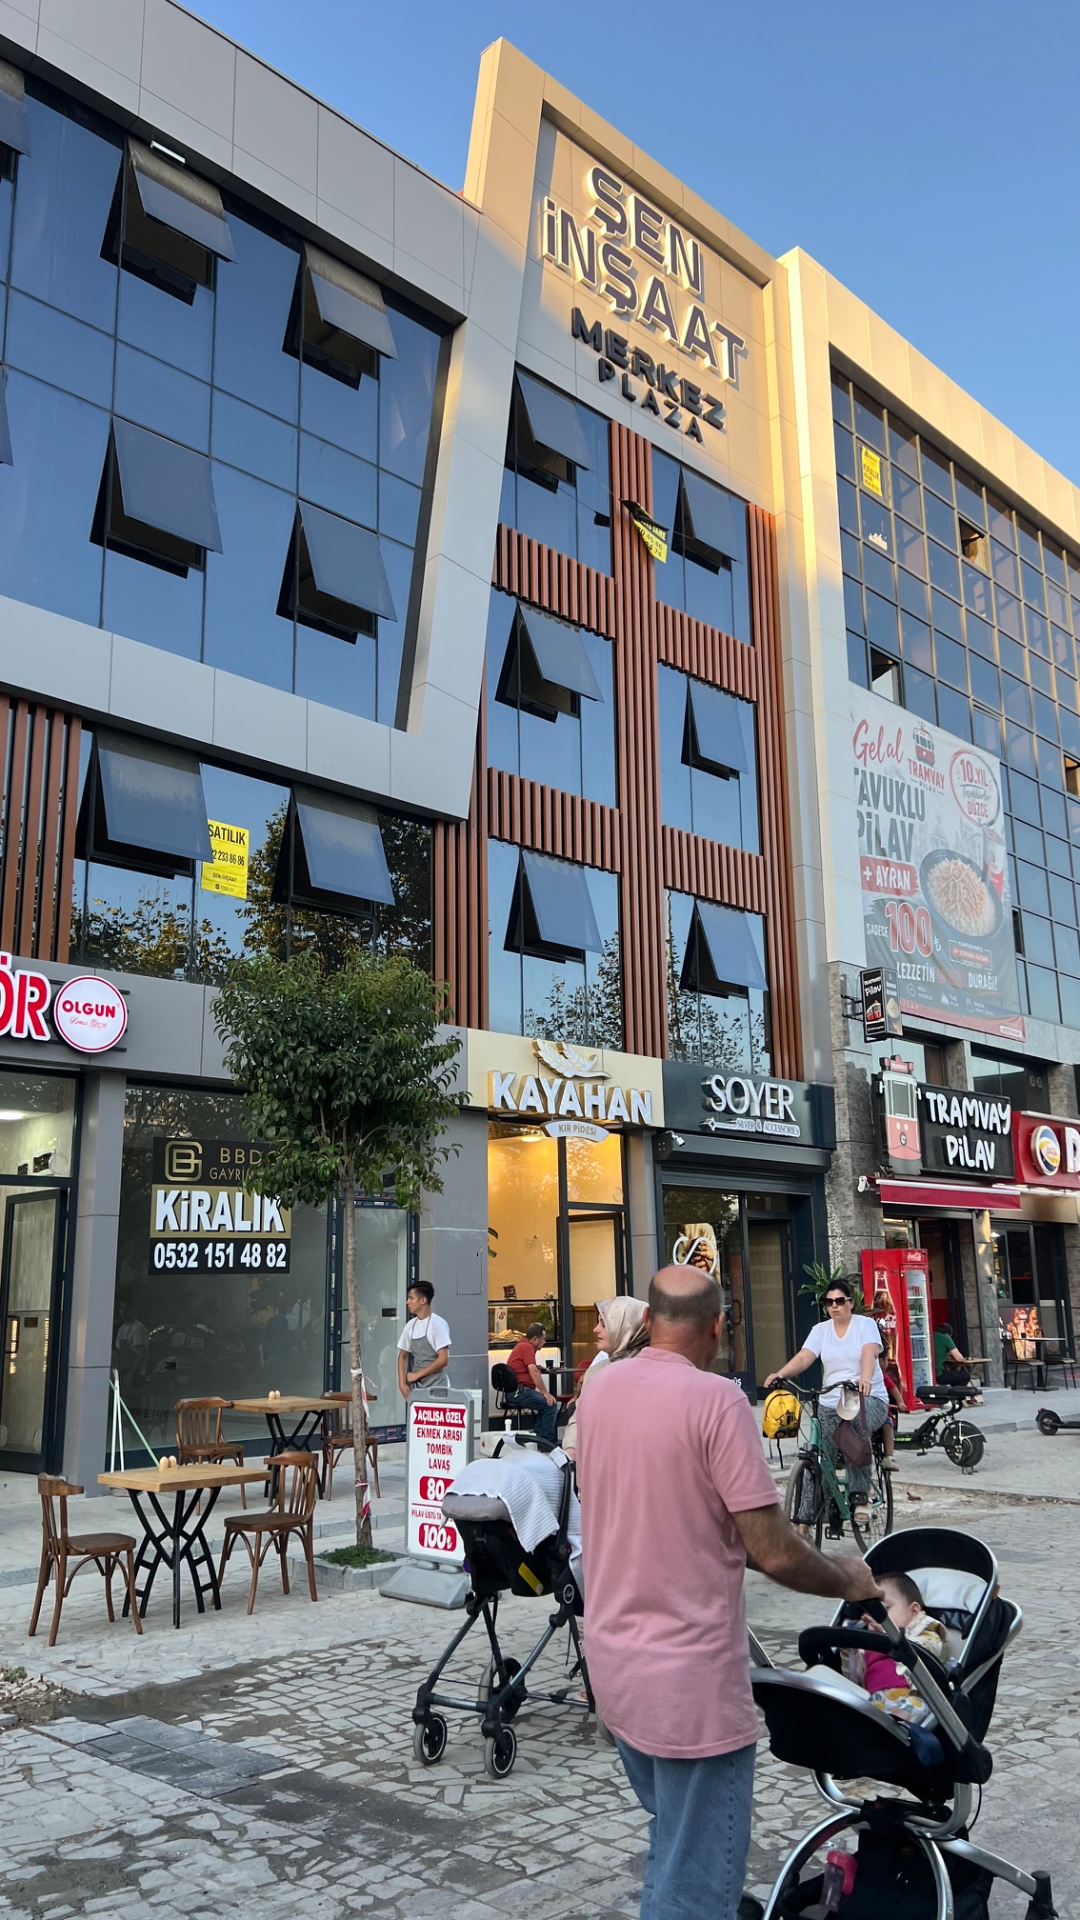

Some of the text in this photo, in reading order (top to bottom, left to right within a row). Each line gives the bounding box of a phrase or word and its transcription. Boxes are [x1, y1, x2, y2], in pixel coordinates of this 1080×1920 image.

[571, 306, 726, 430] MERKEZ
[598, 357, 703, 444] PLAZA
[852, 718, 904, 768] Gel al
[908, 758, 945, 790] TRAMVAY
[208, 823, 246, 846] SATILIK
[876, 865, 911, 891] AYRAN
[866, 922, 889, 938] SADECE
[62, 1000, 116, 1018] OLGUN
[489, 1071, 651, 1125] KAYAHAN
[709, 1074, 797, 1122] SOYER
[924, 1091, 1012, 1135] TRAMVAY
[558, 1123, 572, 1134] KIR
[153, 1242, 287, 1269] 0532 151 48 82
[417, 1408, 463, 1426] AÇILIŞA ÖZEL
[416, 1427, 463, 1442] EKMEK ARASI
[428, 1458, 451, 1474] LAVAŞ
